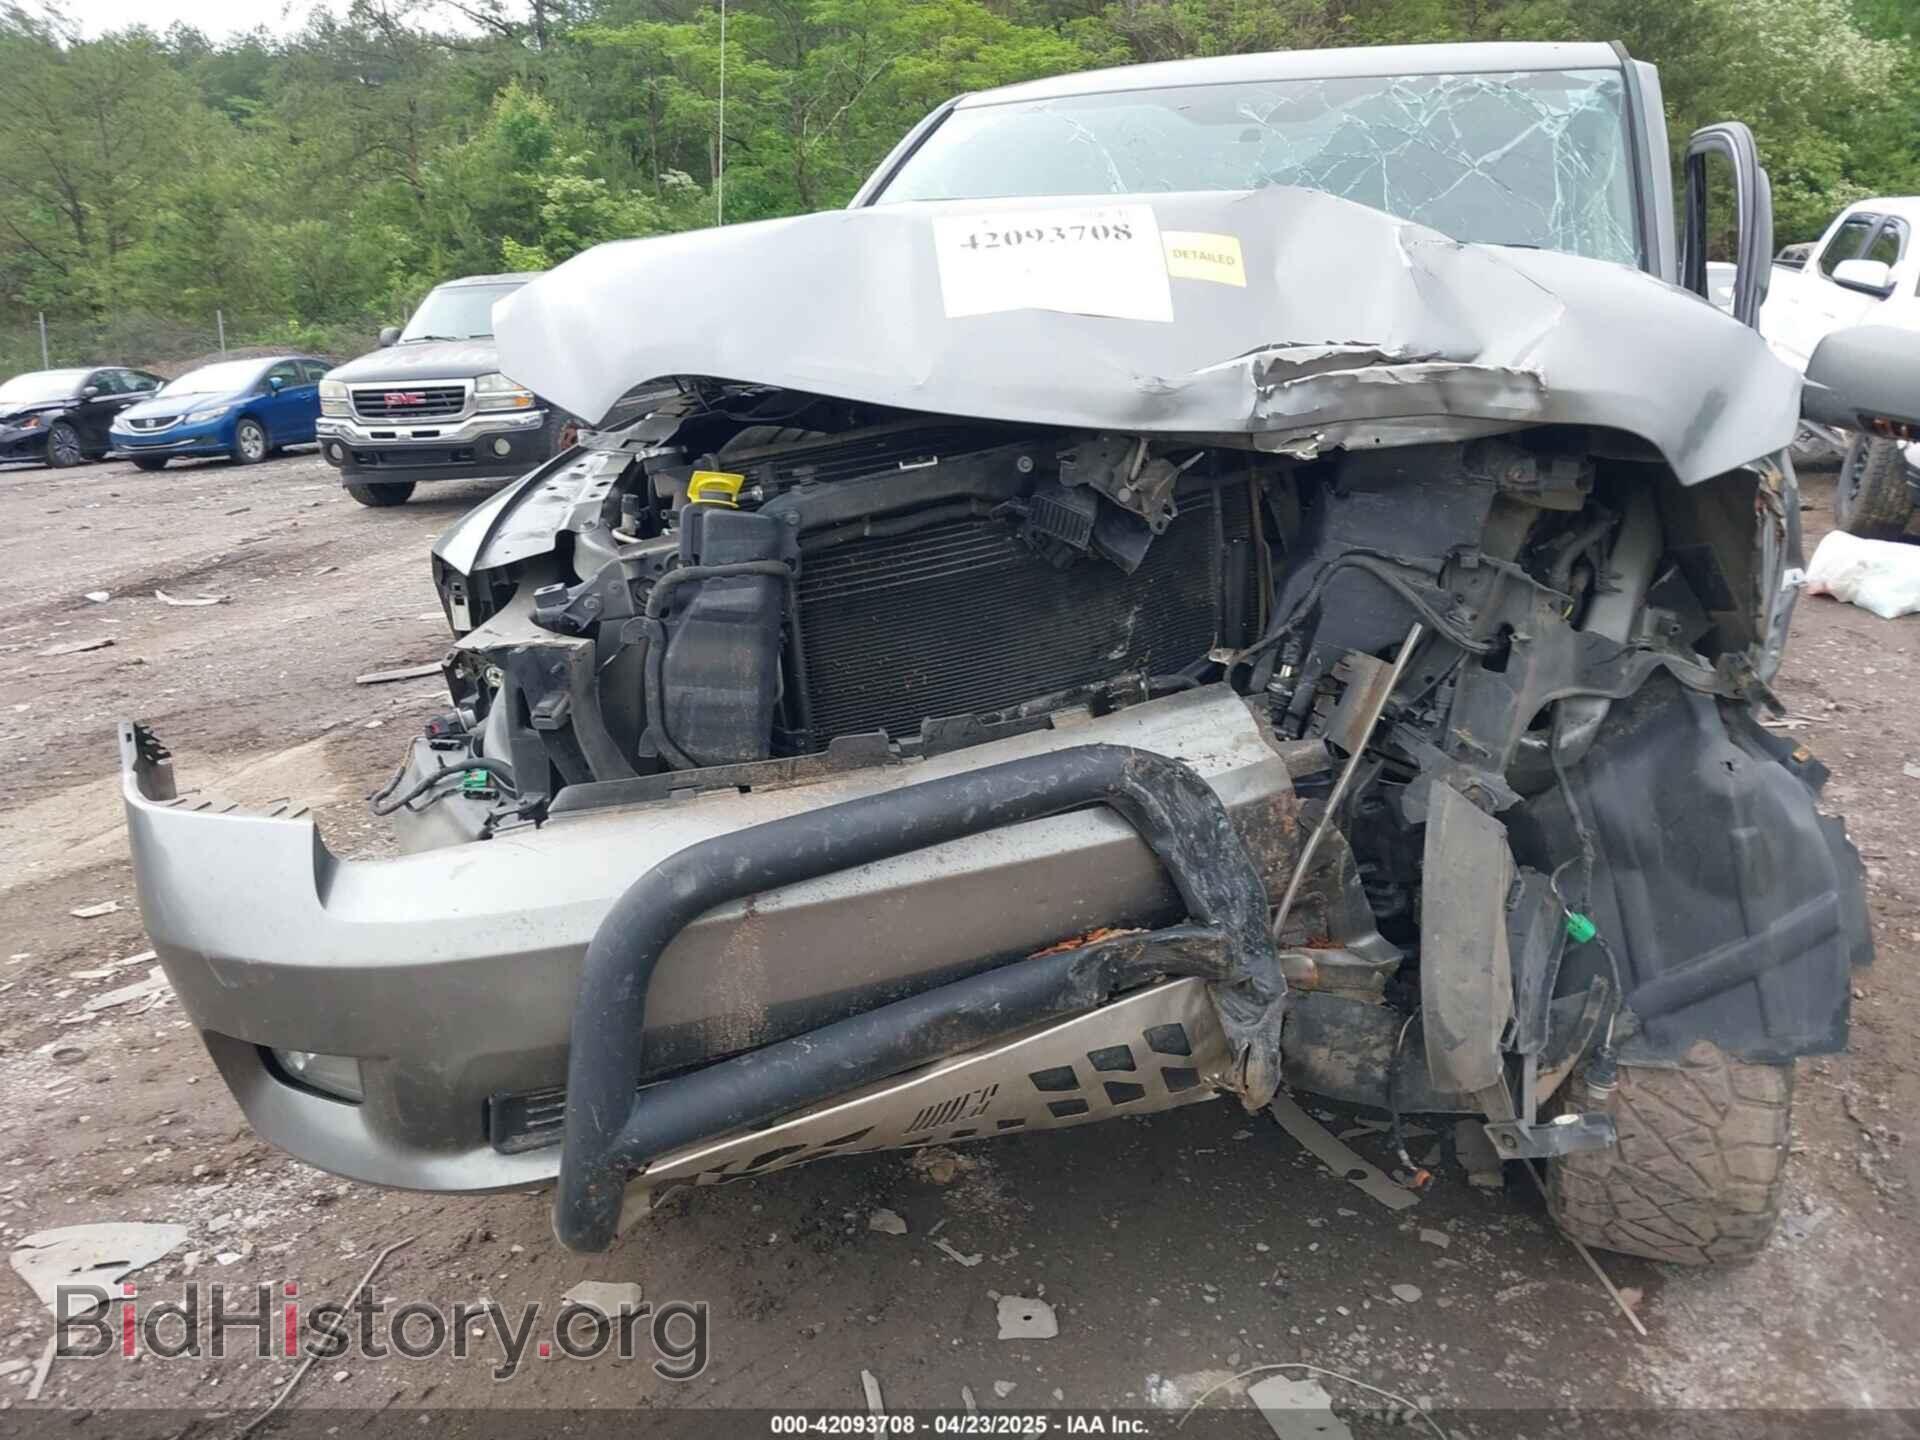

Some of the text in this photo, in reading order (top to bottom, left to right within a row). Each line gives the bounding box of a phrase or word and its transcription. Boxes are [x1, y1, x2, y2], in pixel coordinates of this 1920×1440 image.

[960, 223, 1134, 251] 42093708
[1172, 246, 1236, 267] DETAILED
[384, 391, 427, 406] GMC
